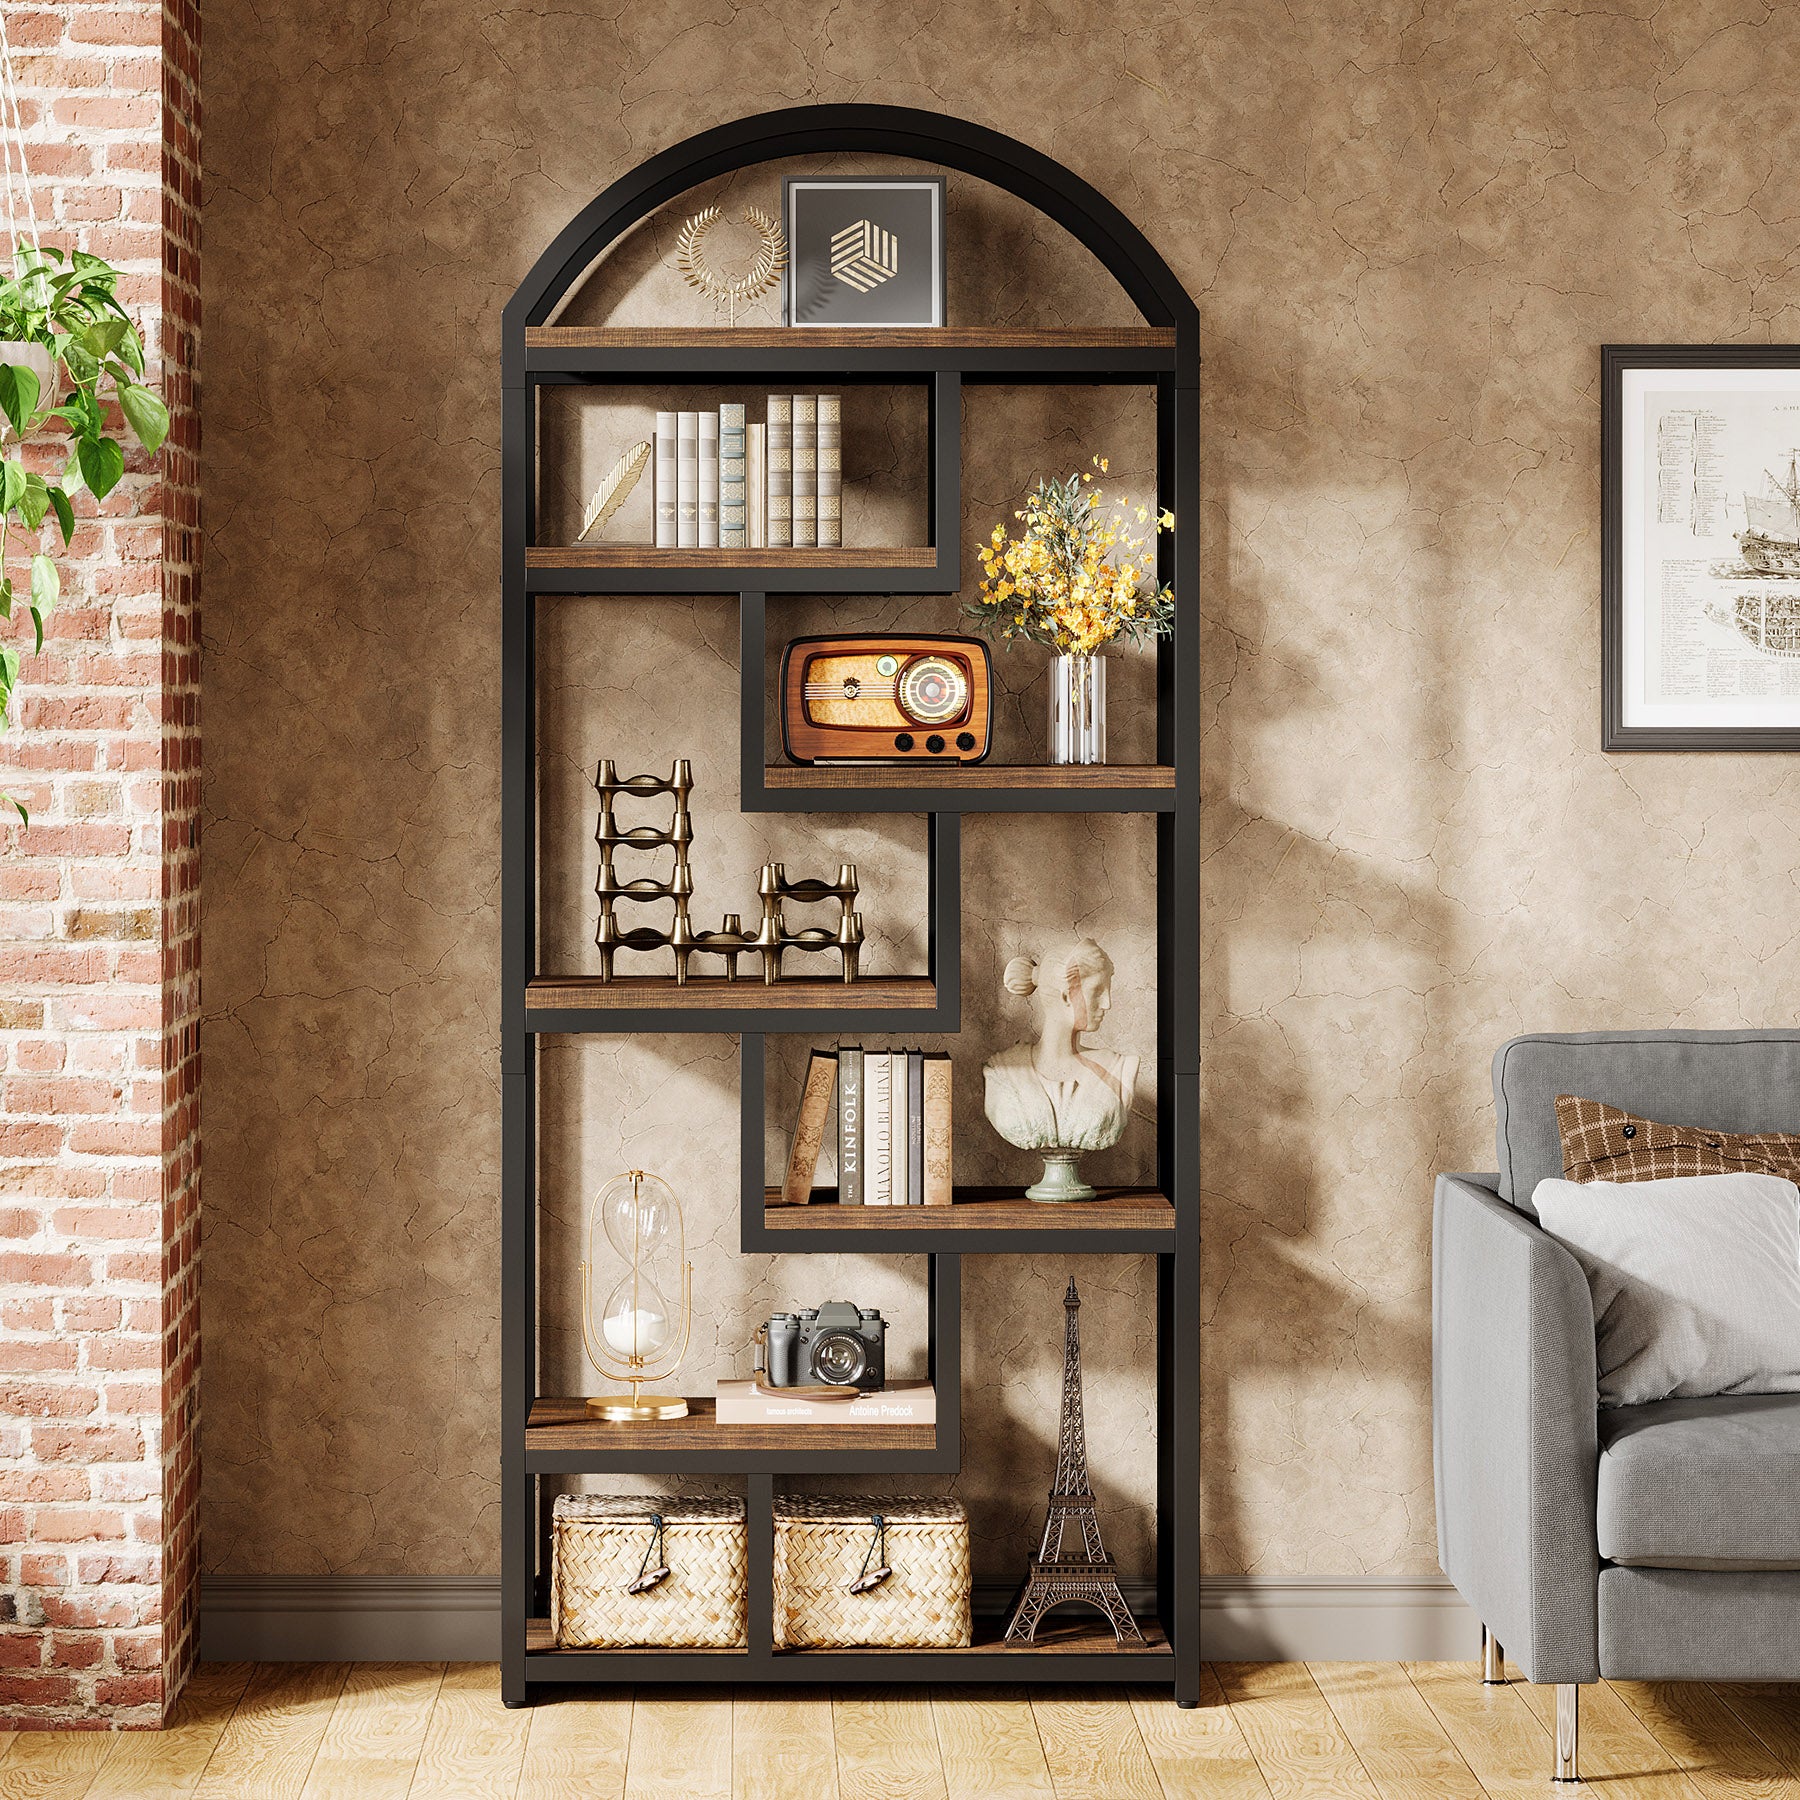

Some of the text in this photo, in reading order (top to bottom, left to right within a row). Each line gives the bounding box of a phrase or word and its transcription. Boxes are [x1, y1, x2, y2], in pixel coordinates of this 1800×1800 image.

[844, 1083, 857, 1173] KINFOLK
[877, 1130, 890, 1200] MANOLO
[849, 1405, 913, 1417] Antoine Predock
